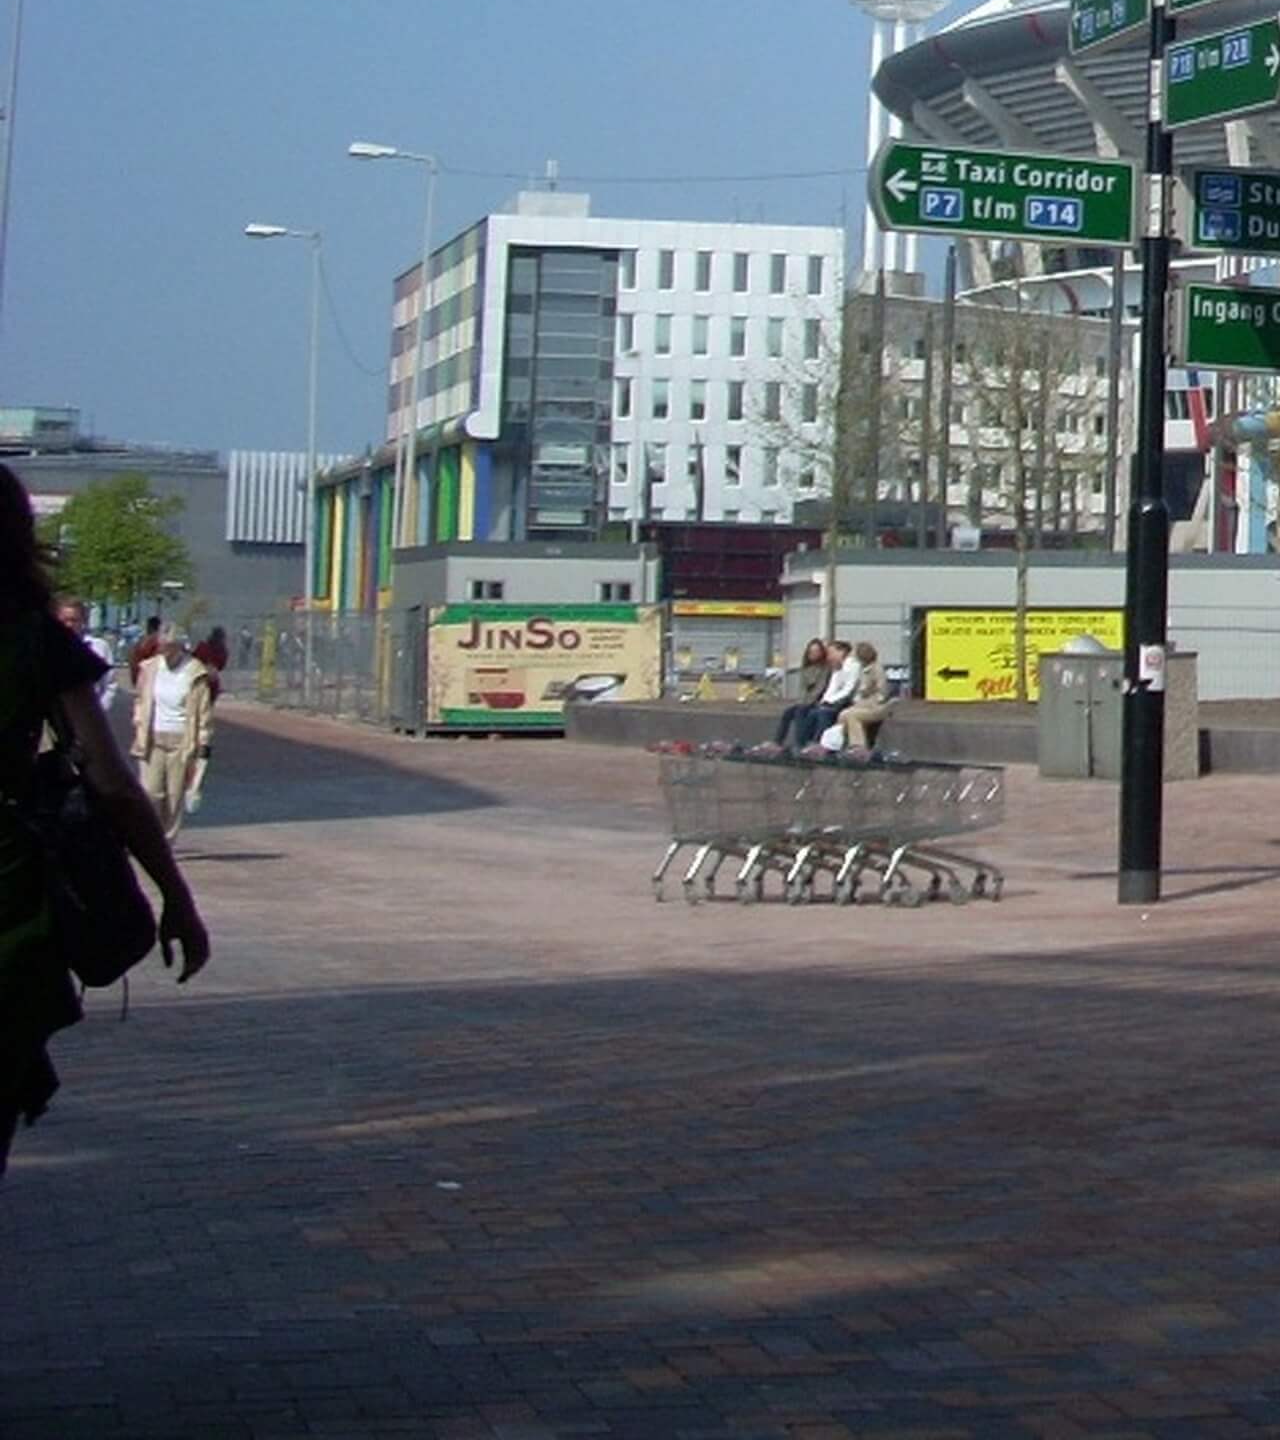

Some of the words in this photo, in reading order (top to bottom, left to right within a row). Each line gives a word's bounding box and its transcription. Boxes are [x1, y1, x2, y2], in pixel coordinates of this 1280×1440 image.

[955, 159, 1004, 184] Taxi
[1013, 163, 1116, 193] Corridor
[925, 194, 957, 216] P7
[972, 196, 1016, 220] t/m
[1029, 201, 1075, 225] P14
[1193, 294, 1266, 327] Ingang
